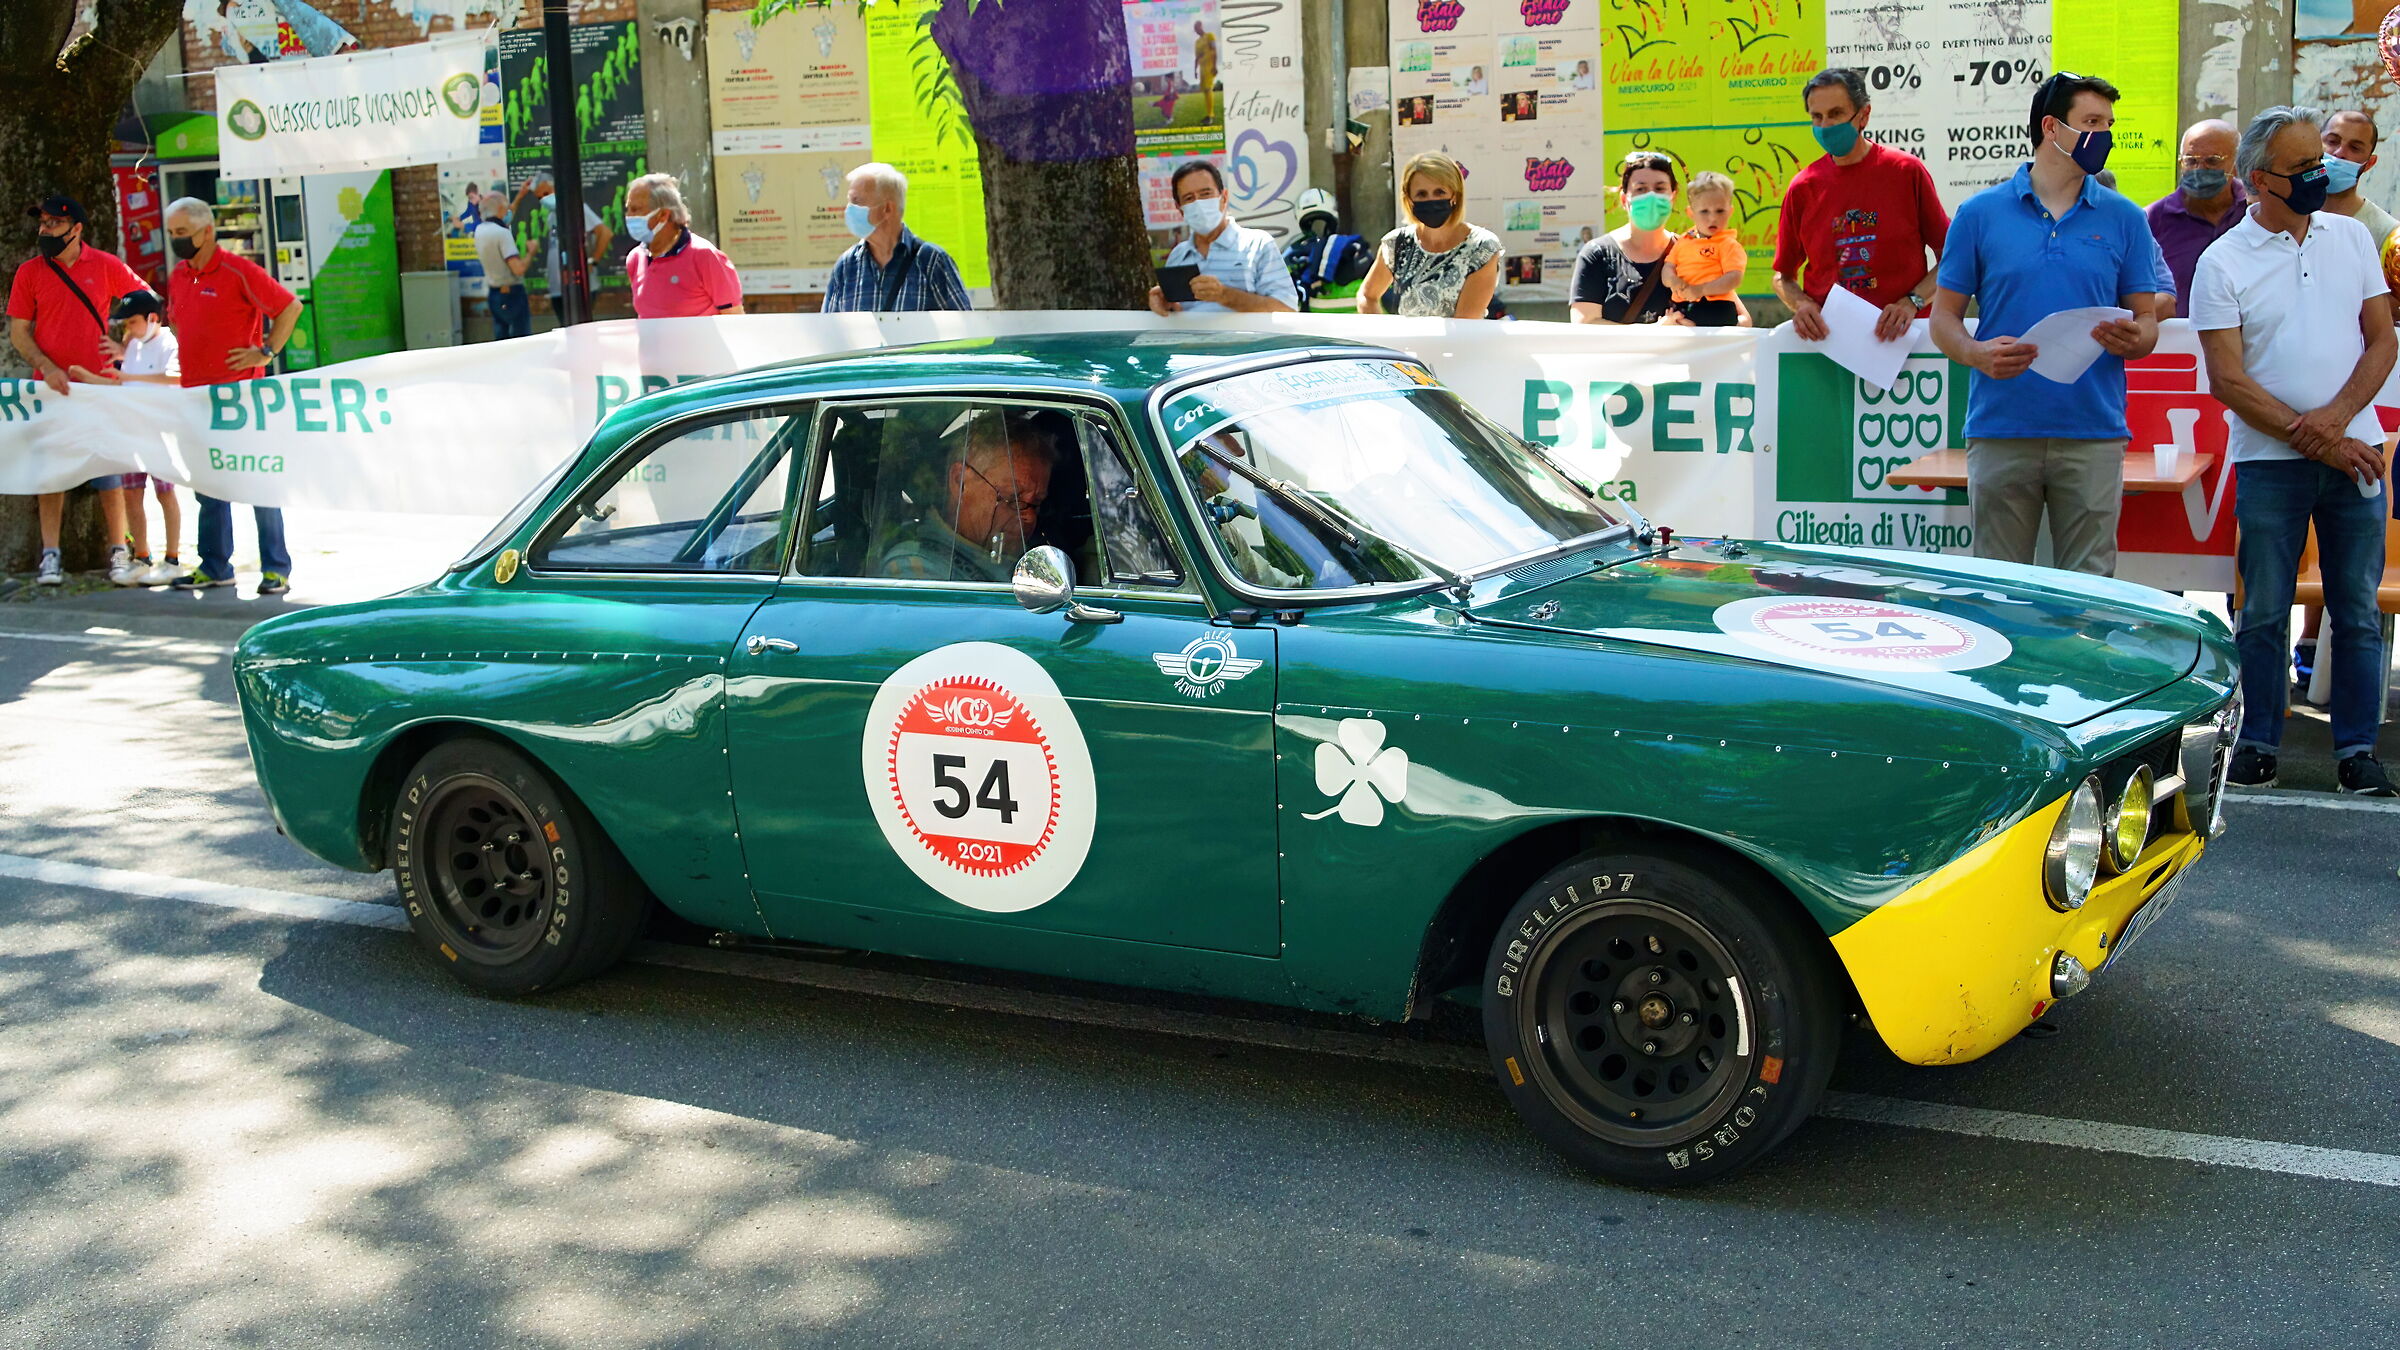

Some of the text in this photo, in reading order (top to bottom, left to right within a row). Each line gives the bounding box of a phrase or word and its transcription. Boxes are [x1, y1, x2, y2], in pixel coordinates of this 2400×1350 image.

[1854, 43, 1883, 53] THING
[1887, 41, 1912, 52] MUST
[1915, 40, 1930, 50] GO
[1942, 34, 2053, 49] EVERY THING MUST GO
[1609, 55, 1704, 85] Viva la Vida
[1719, 49, 1818, 80] Viva la Vida
[1954, 58, 2043, 87] -70%
[267, 86, 441, 134] CLASSIC CLUB VIGNOLA
[1863, 127, 1926, 144] RKING
[1947, 124, 2031, 142] WORKIN
[1947, 144, 2036, 161] PROGRA
[208, 378, 392, 433] BPER:
[208, 447, 284, 474] Banca
[1776, 509, 1974, 554] Ciliegia di Vigno
[1203, 630, 1232, 643] ALFA
[1811, 621, 1927, 642] 54
[1173, 677, 1225, 699] REVIVAL CUP
[932, 752, 1019, 825] 54
[397, 811, 425, 918] PIRELLI
[956, 841, 1003, 863] 2021
[545, 846, 570, 946] CORSA
[1497, 873, 1635, 997] PIRELLI P7
